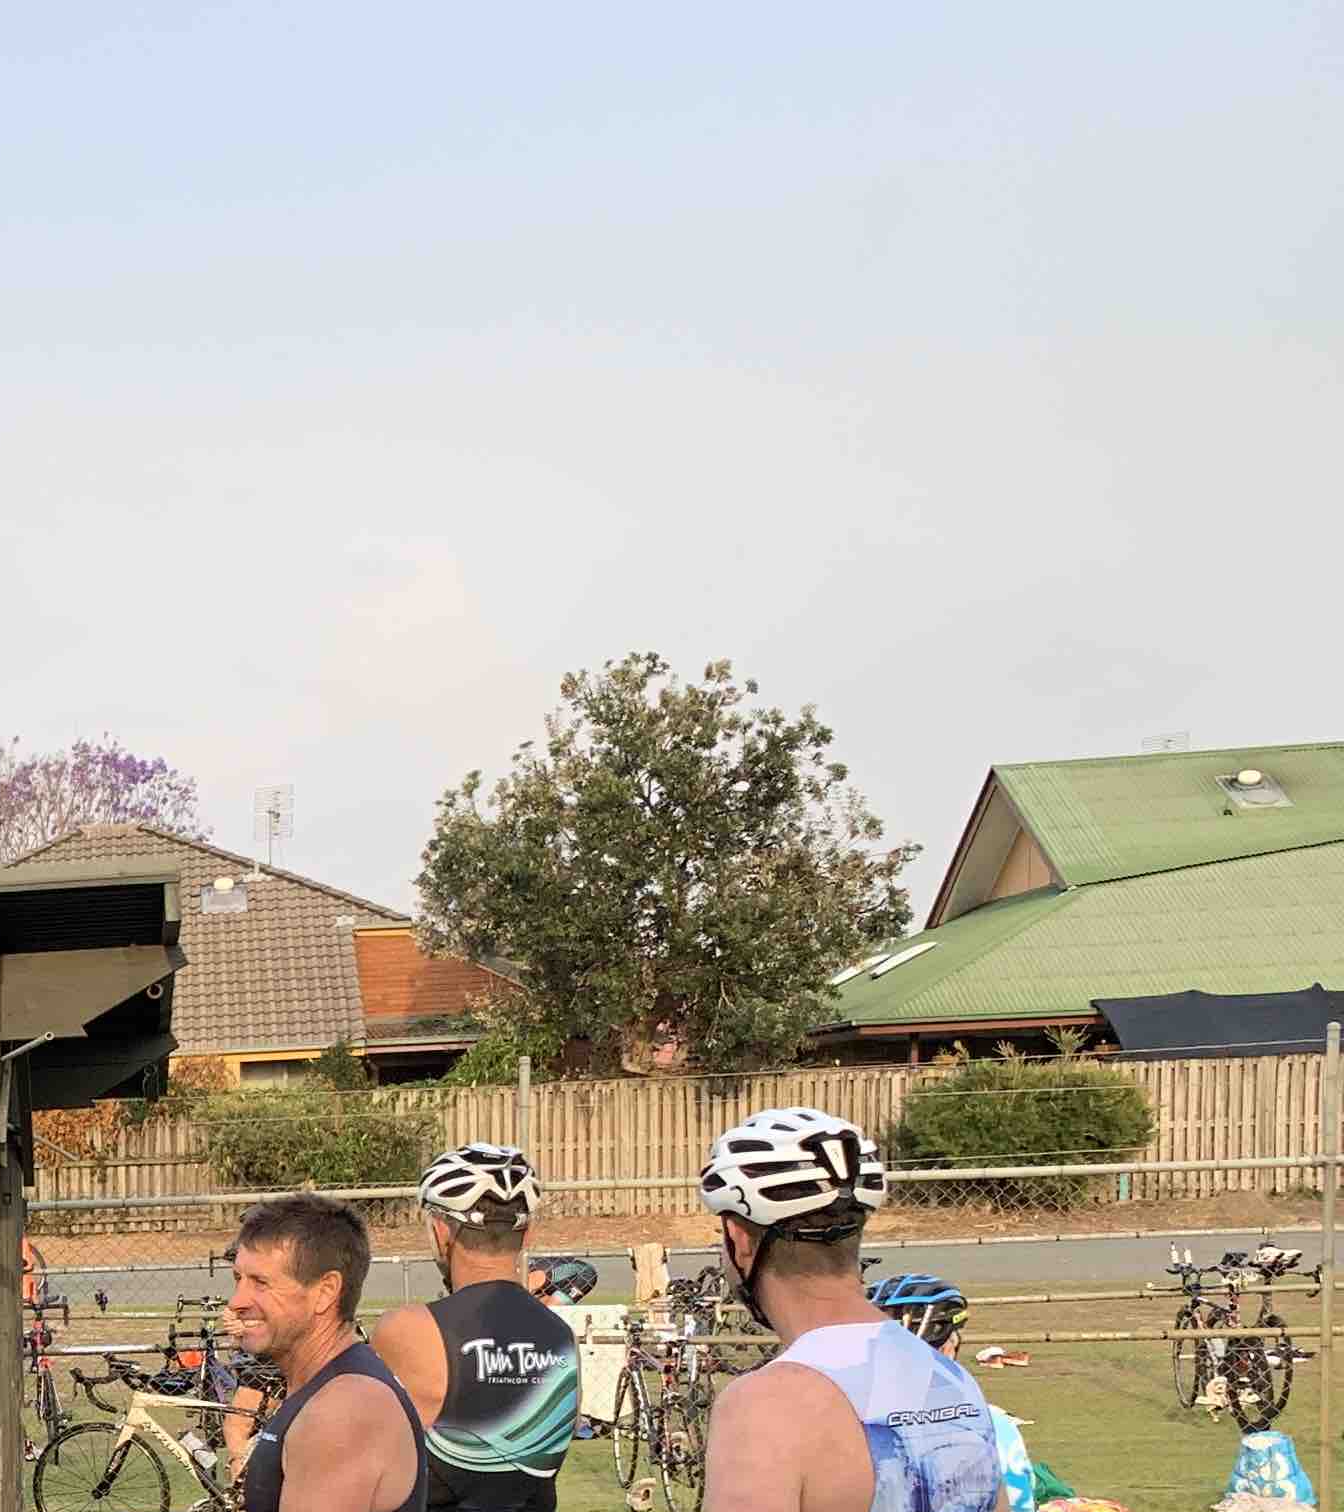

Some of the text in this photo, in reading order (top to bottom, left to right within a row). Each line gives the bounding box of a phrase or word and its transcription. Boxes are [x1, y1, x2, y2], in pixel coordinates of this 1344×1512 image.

[461, 1338, 569, 1381] Twin Towns
[886, 1404, 982, 1428] CANNIBAL
